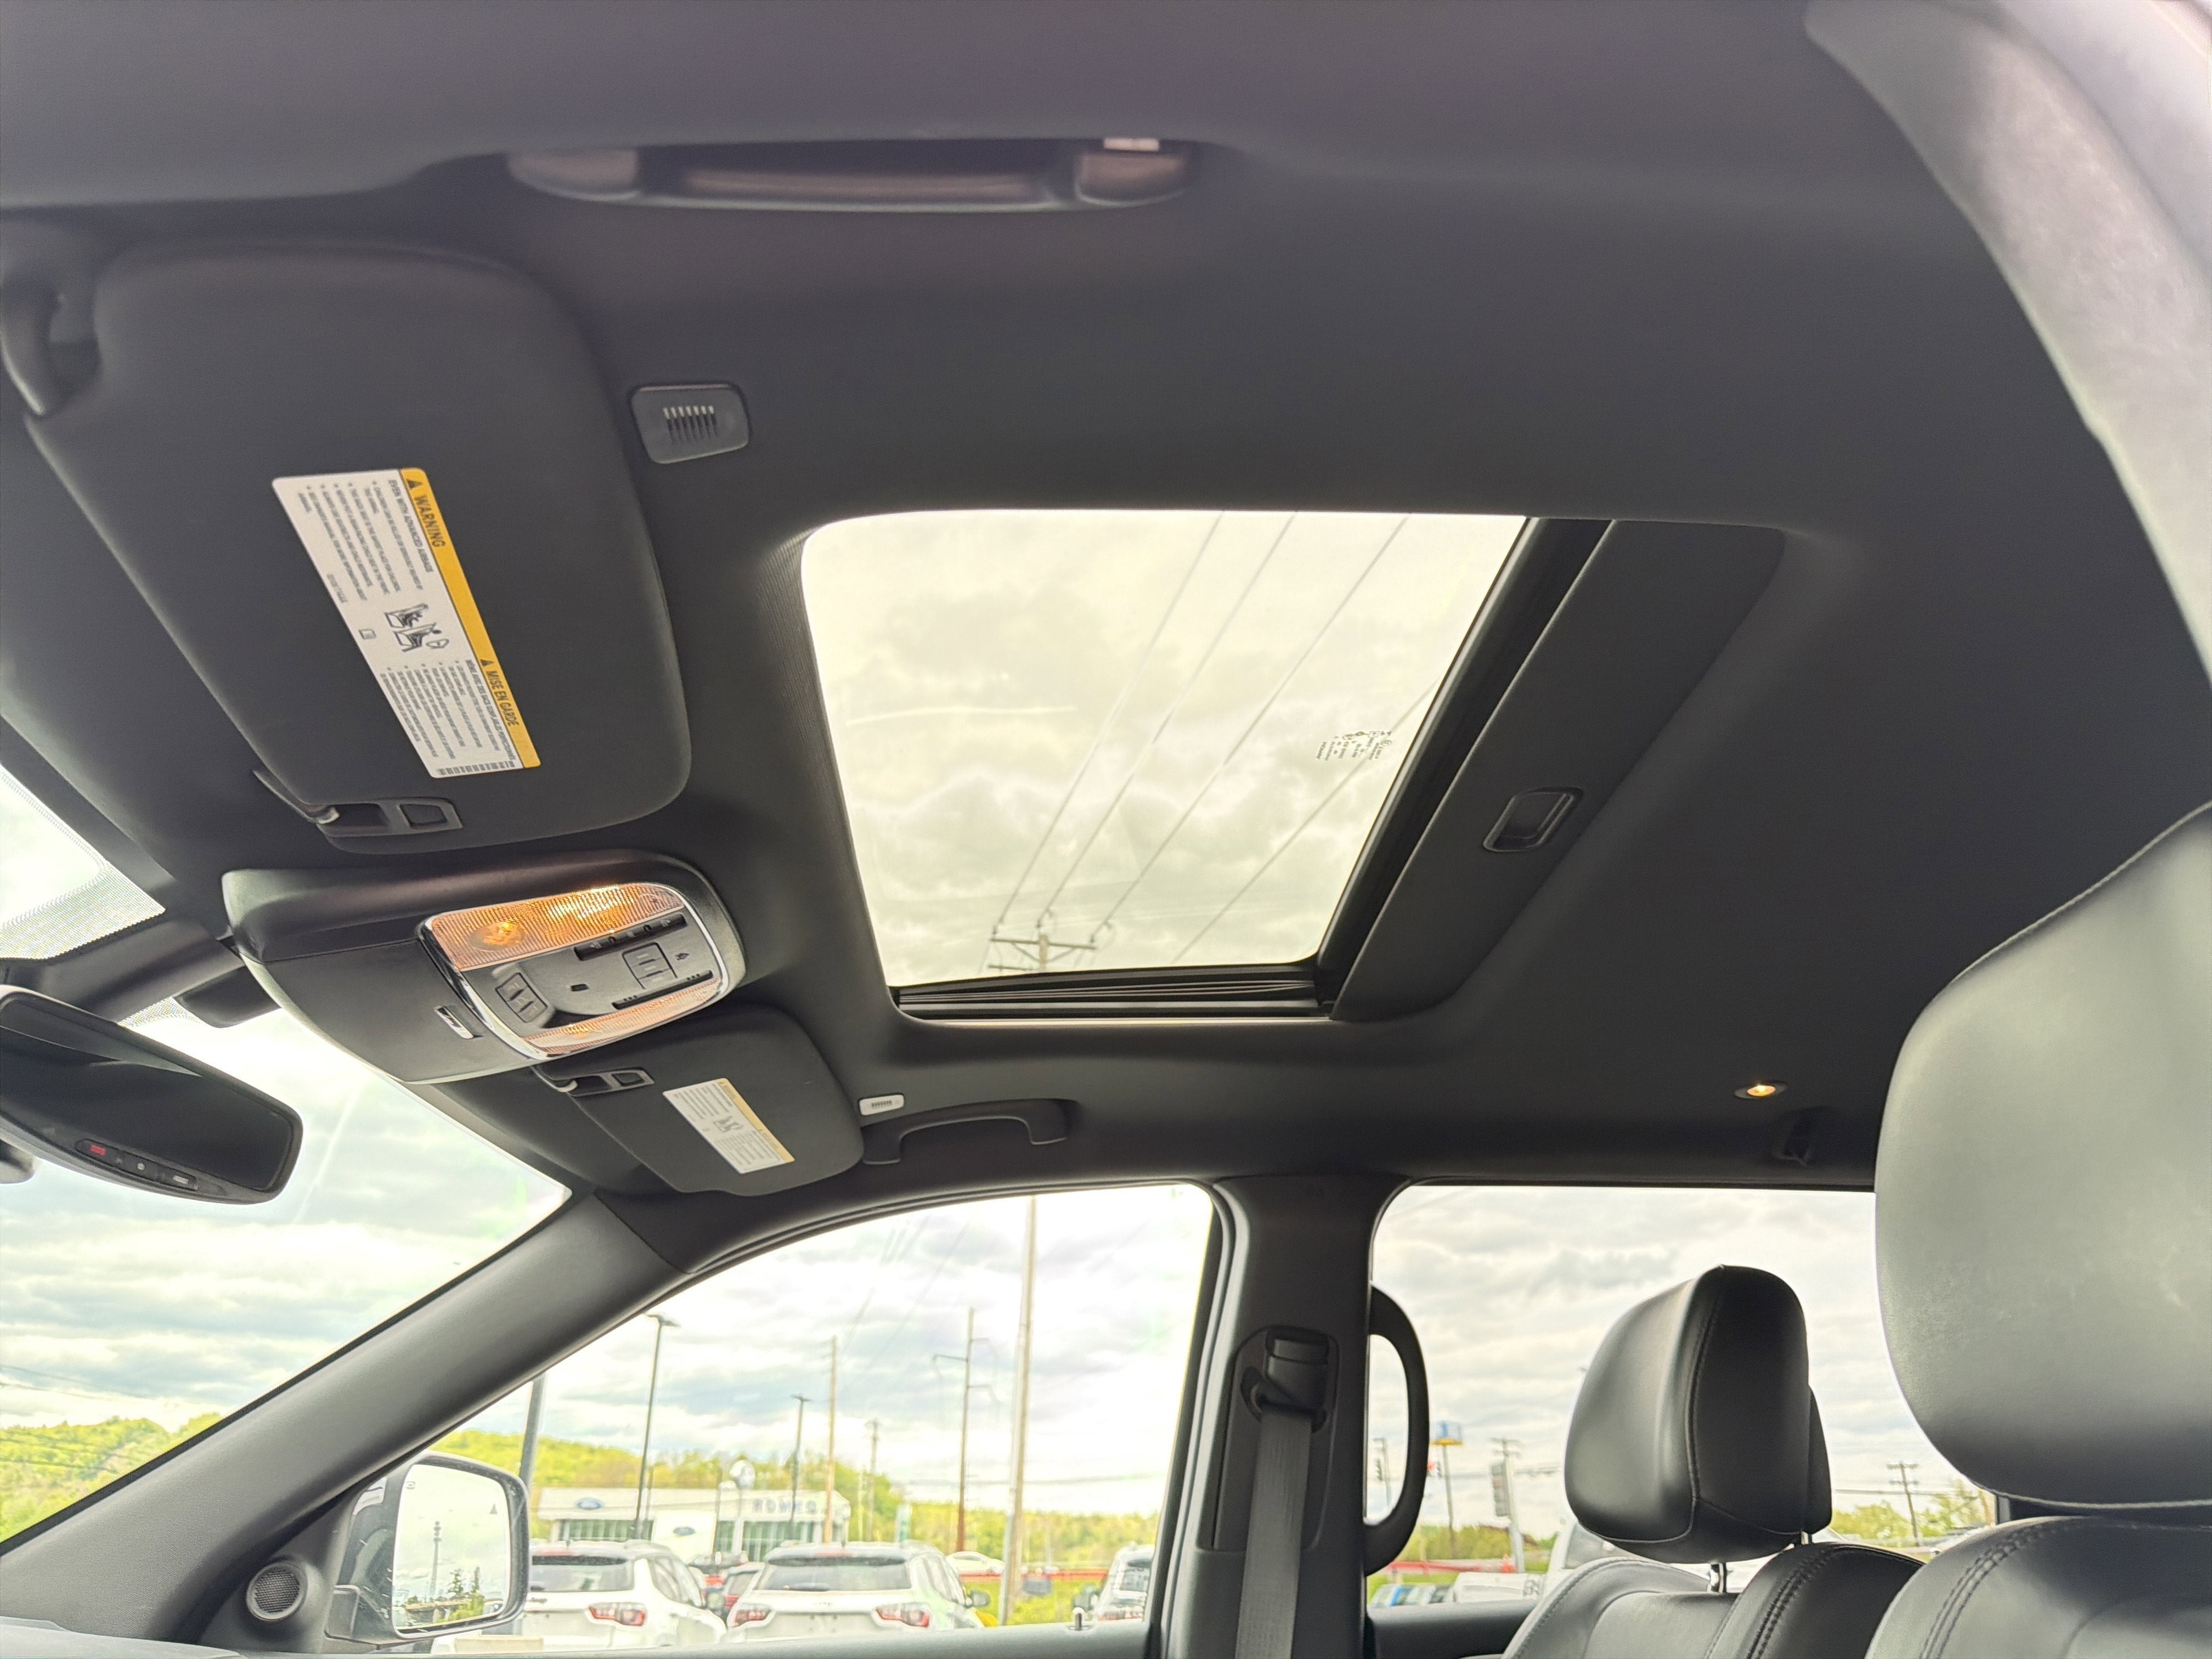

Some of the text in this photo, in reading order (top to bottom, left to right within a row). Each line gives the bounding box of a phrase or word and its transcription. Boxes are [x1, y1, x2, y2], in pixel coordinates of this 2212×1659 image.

[414, 495, 445, 547] WARNING
[486, 670, 504, 690] MISE
[494, 691, 509, 701] EN
[500, 702, 520, 726] GARDE
